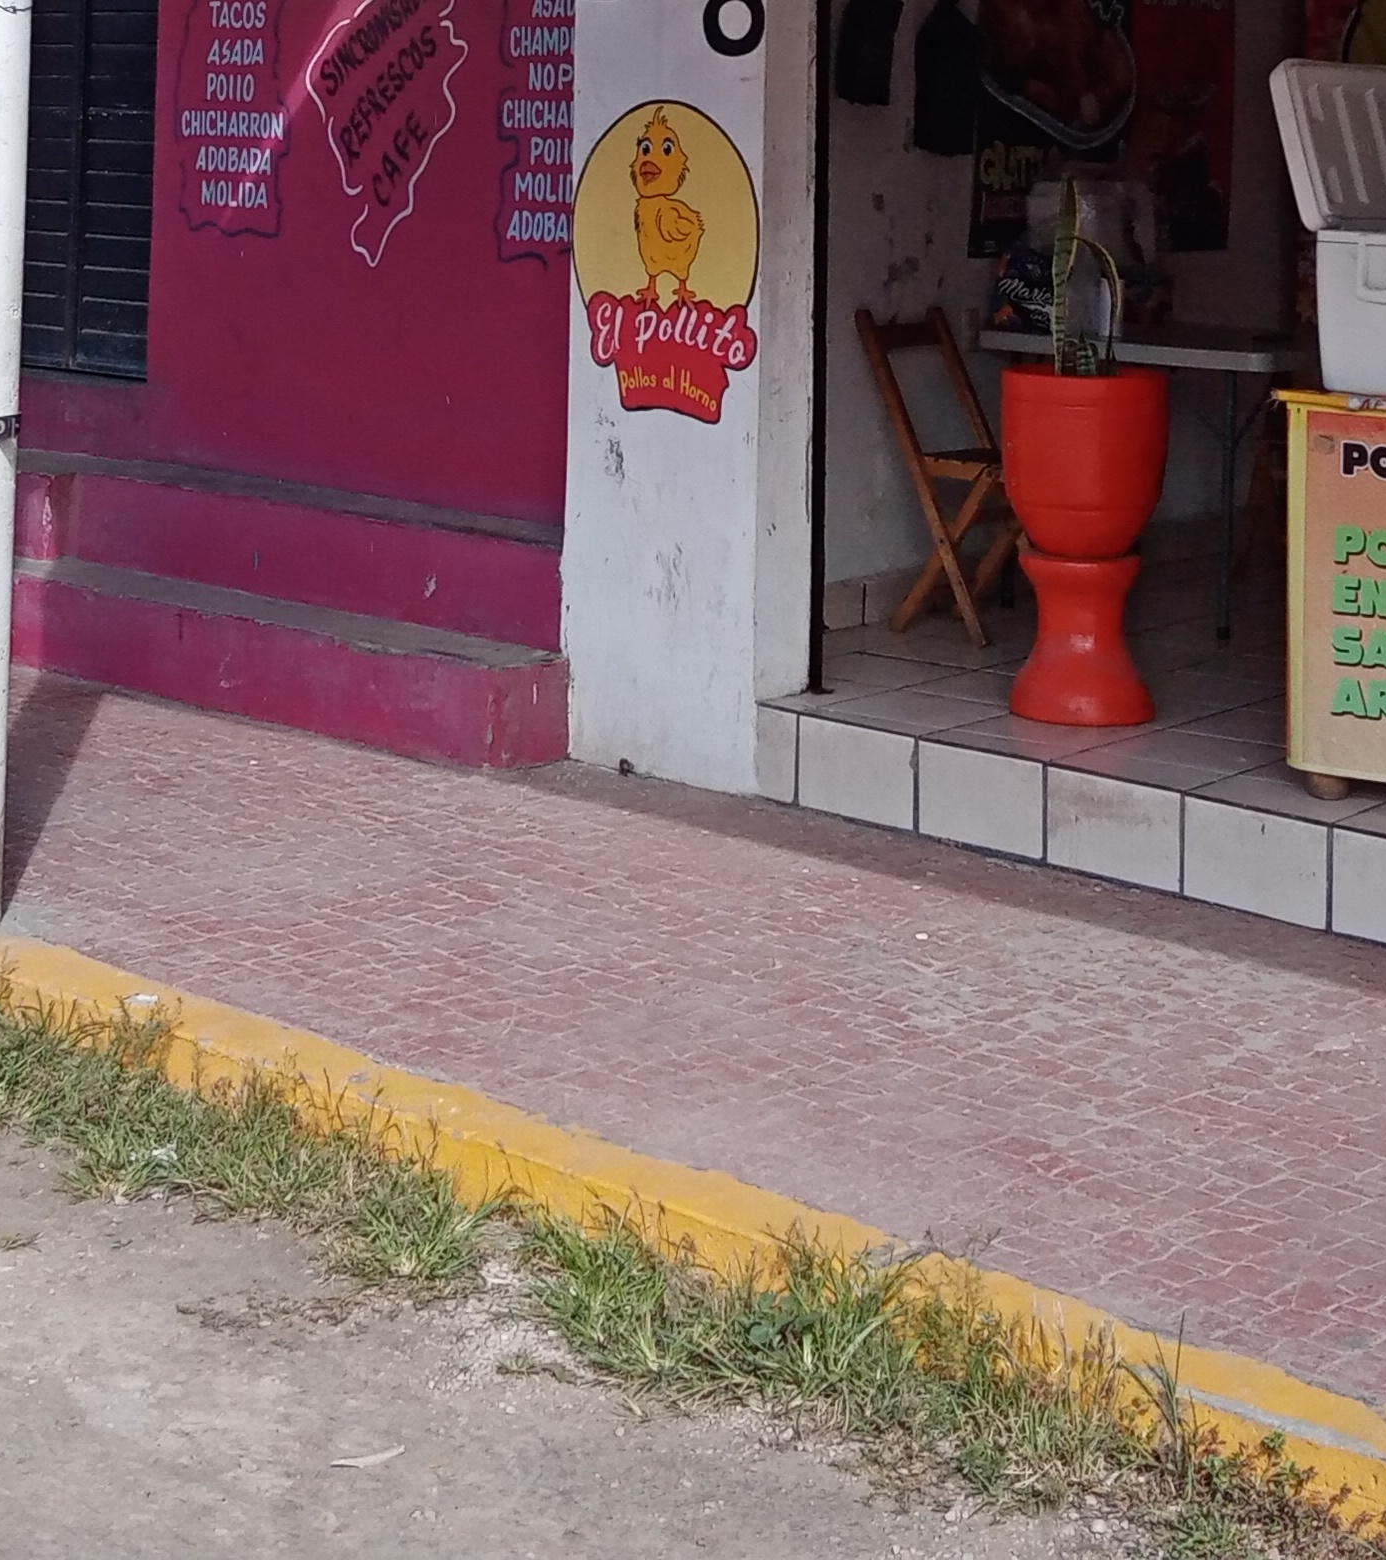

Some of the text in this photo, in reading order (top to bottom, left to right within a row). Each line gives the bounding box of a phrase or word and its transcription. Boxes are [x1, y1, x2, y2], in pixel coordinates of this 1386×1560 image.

[209, 0, 267, 29] TACOS
[207, 37, 264, 66] ASADA
[528, 62, 574, 91] NOP
[338, 25, 438, 169] REFRESCOS
[181, 110, 284, 140] CHICHARRON
[195, 146, 272, 176] ADOBADA
[372, 108, 429, 208] CAFE
[201, 180, 269, 210] MOLIDA
[514, 172, 572, 203] MOLID
[506, 210, 572, 242] ADOBA
[596, 302, 746, 365] El Pollito
[663, 365, 675, 391] al
[679, 368, 717, 412] Horno
